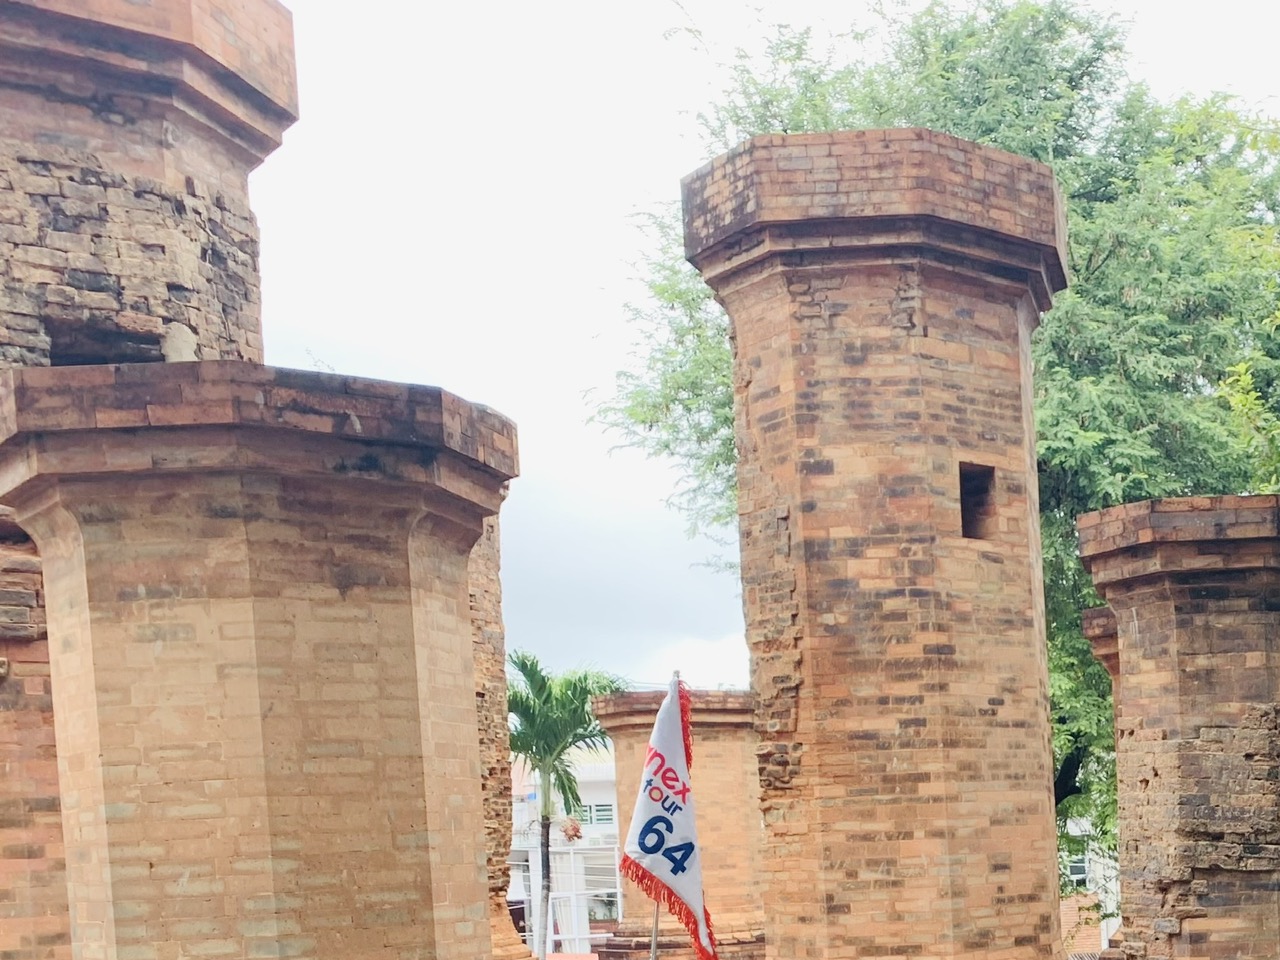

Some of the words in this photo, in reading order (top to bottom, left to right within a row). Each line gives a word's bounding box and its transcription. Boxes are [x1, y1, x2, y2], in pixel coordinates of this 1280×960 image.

[643, 778, 683, 817] tour
[645, 746, 691, 805] nex
[638, 815, 695, 876] 64
